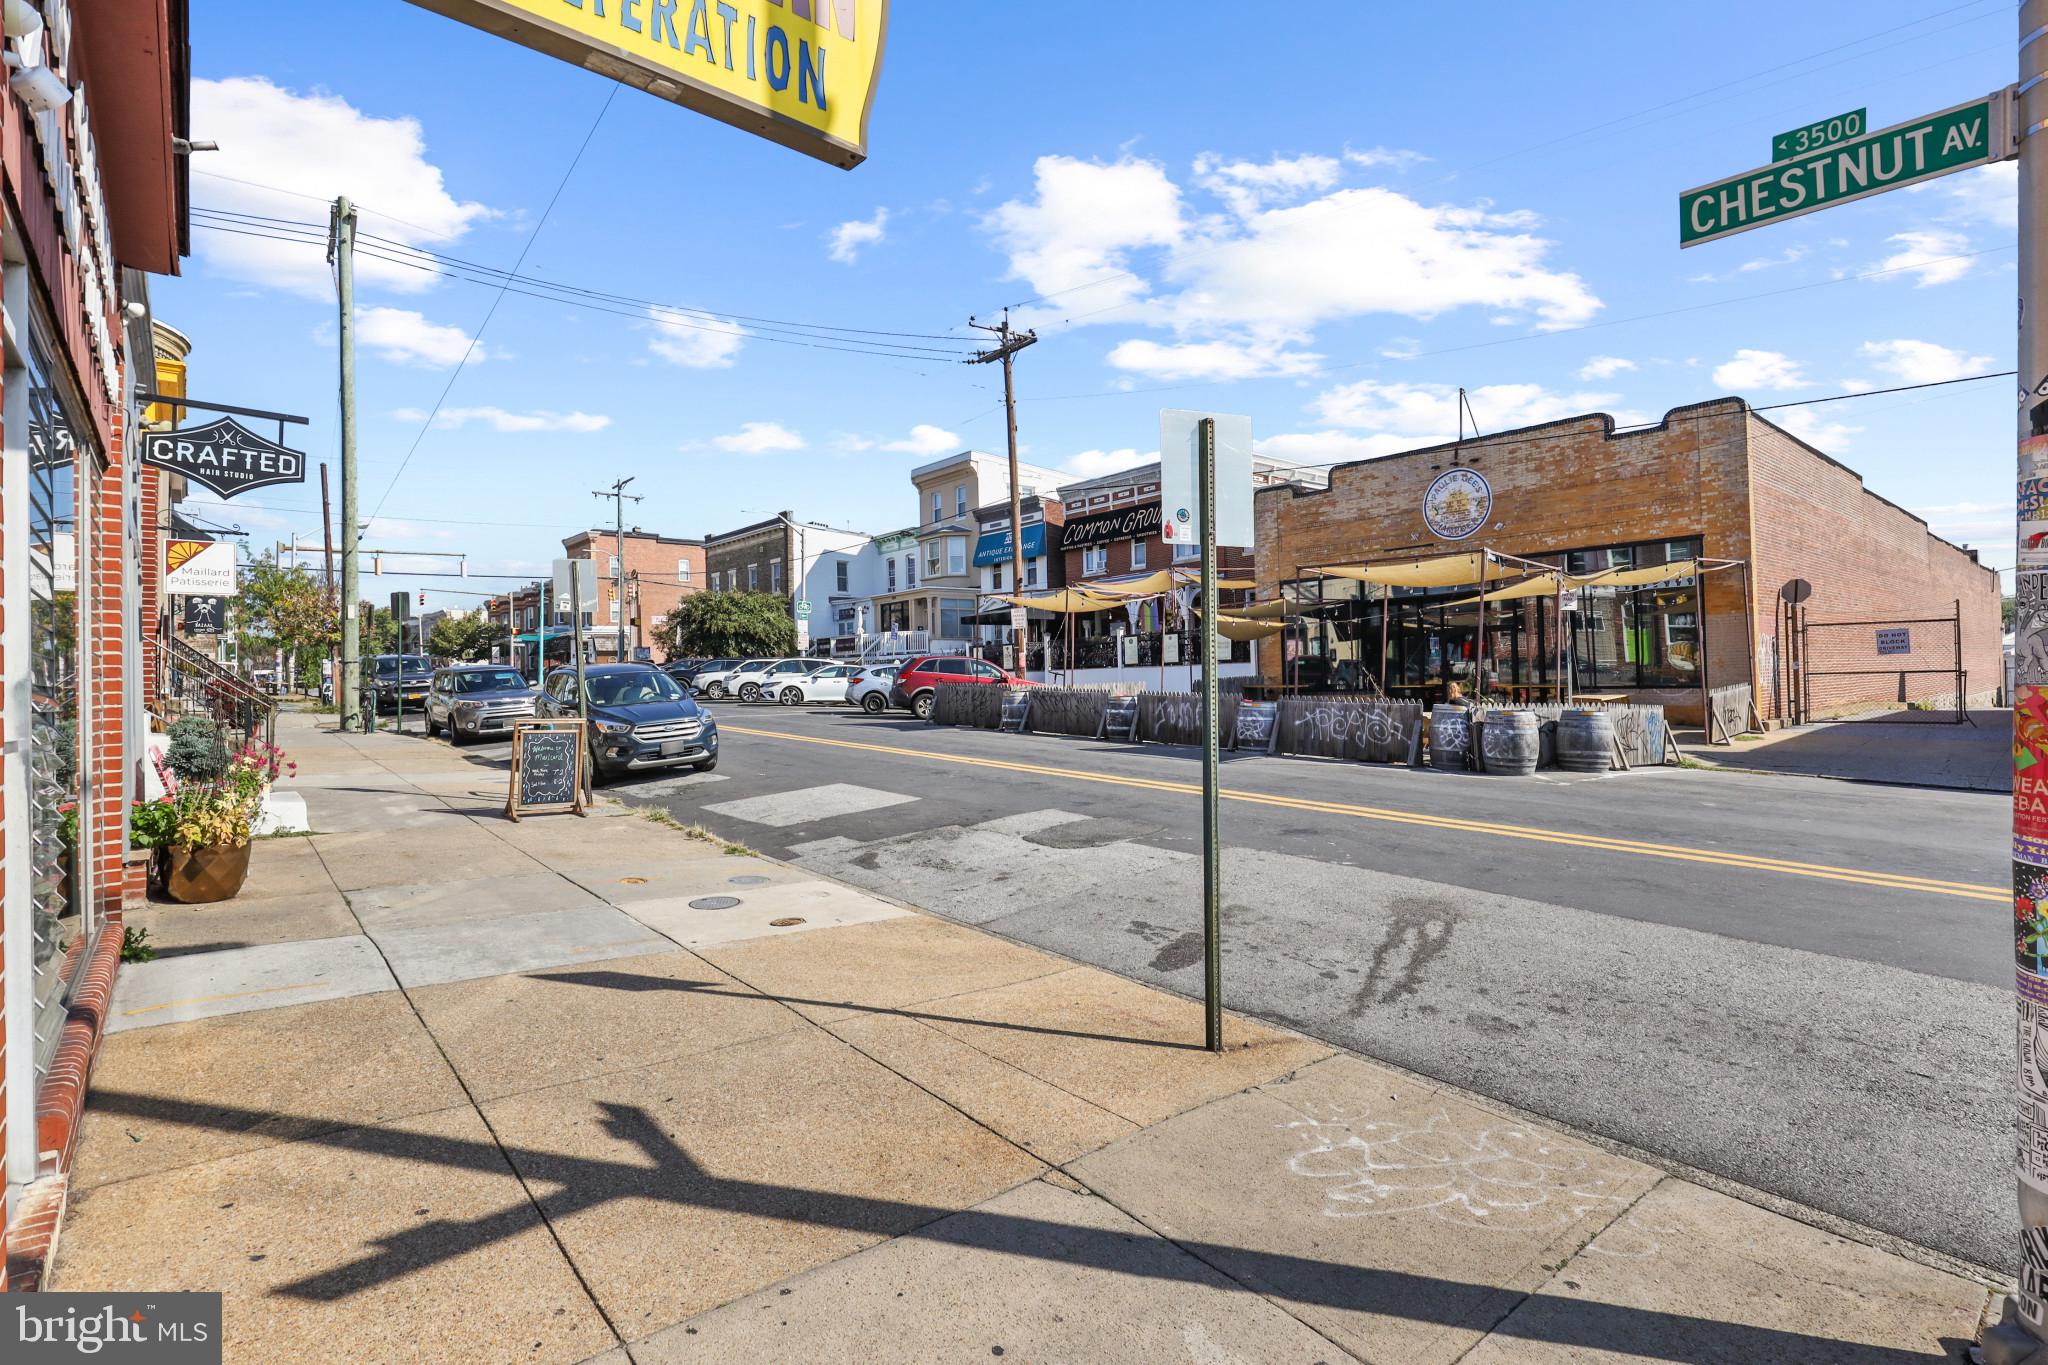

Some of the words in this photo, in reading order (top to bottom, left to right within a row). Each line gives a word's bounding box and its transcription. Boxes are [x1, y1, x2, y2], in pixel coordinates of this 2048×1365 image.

[1795, 114, 1860, 152] 3500
[1691, 126, 1934, 233] CHESTNUT
[1941, 117, 1982, 156] AV.
[153, 439, 296, 475] CRAFTED
[200, 468, 220, 477] HAIR
[224, 471, 254, 480] STUDIO
[1064, 518, 1121, 545] COMMON
[1122, 507, 1162, 533] GROU
[978, 547, 1004, 559] ANTIQUE
[171, 577, 230, 586] Patisserie
[181, 568, 230, 577] Maillard
